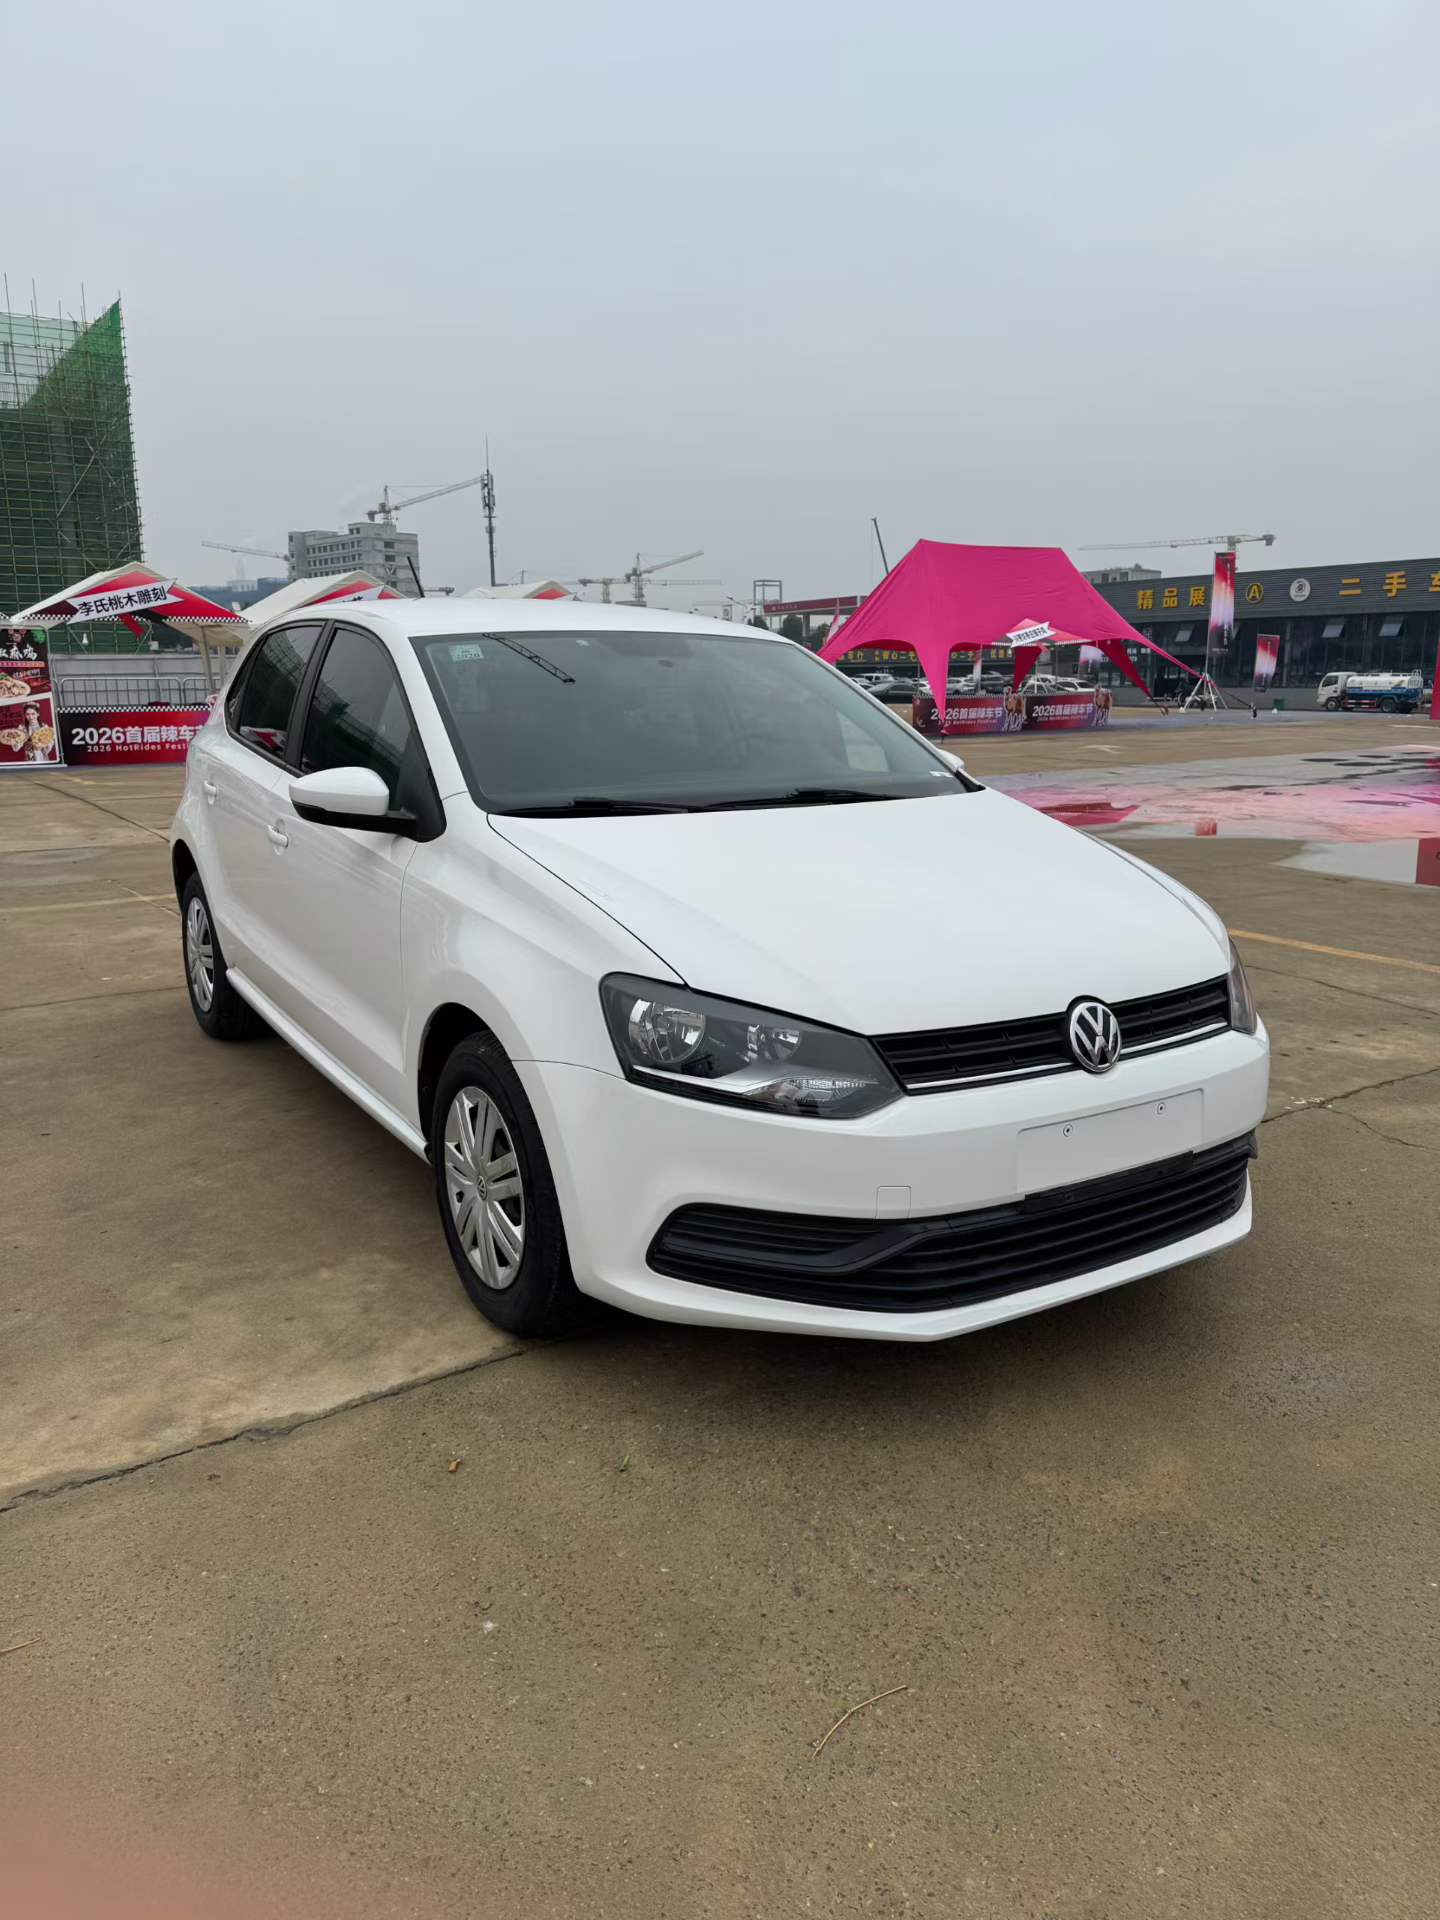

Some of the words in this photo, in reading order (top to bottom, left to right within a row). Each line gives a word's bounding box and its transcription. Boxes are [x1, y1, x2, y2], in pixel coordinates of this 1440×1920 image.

[78, 585, 168, 616] 李氏桃木雕刻
[1137, 586, 1206, 610] 精品展
[71, 725, 202, 745] 2026首届辣车
[86, 745, 112, 753] 2026
[115, 742, 162, 752] HotRides
